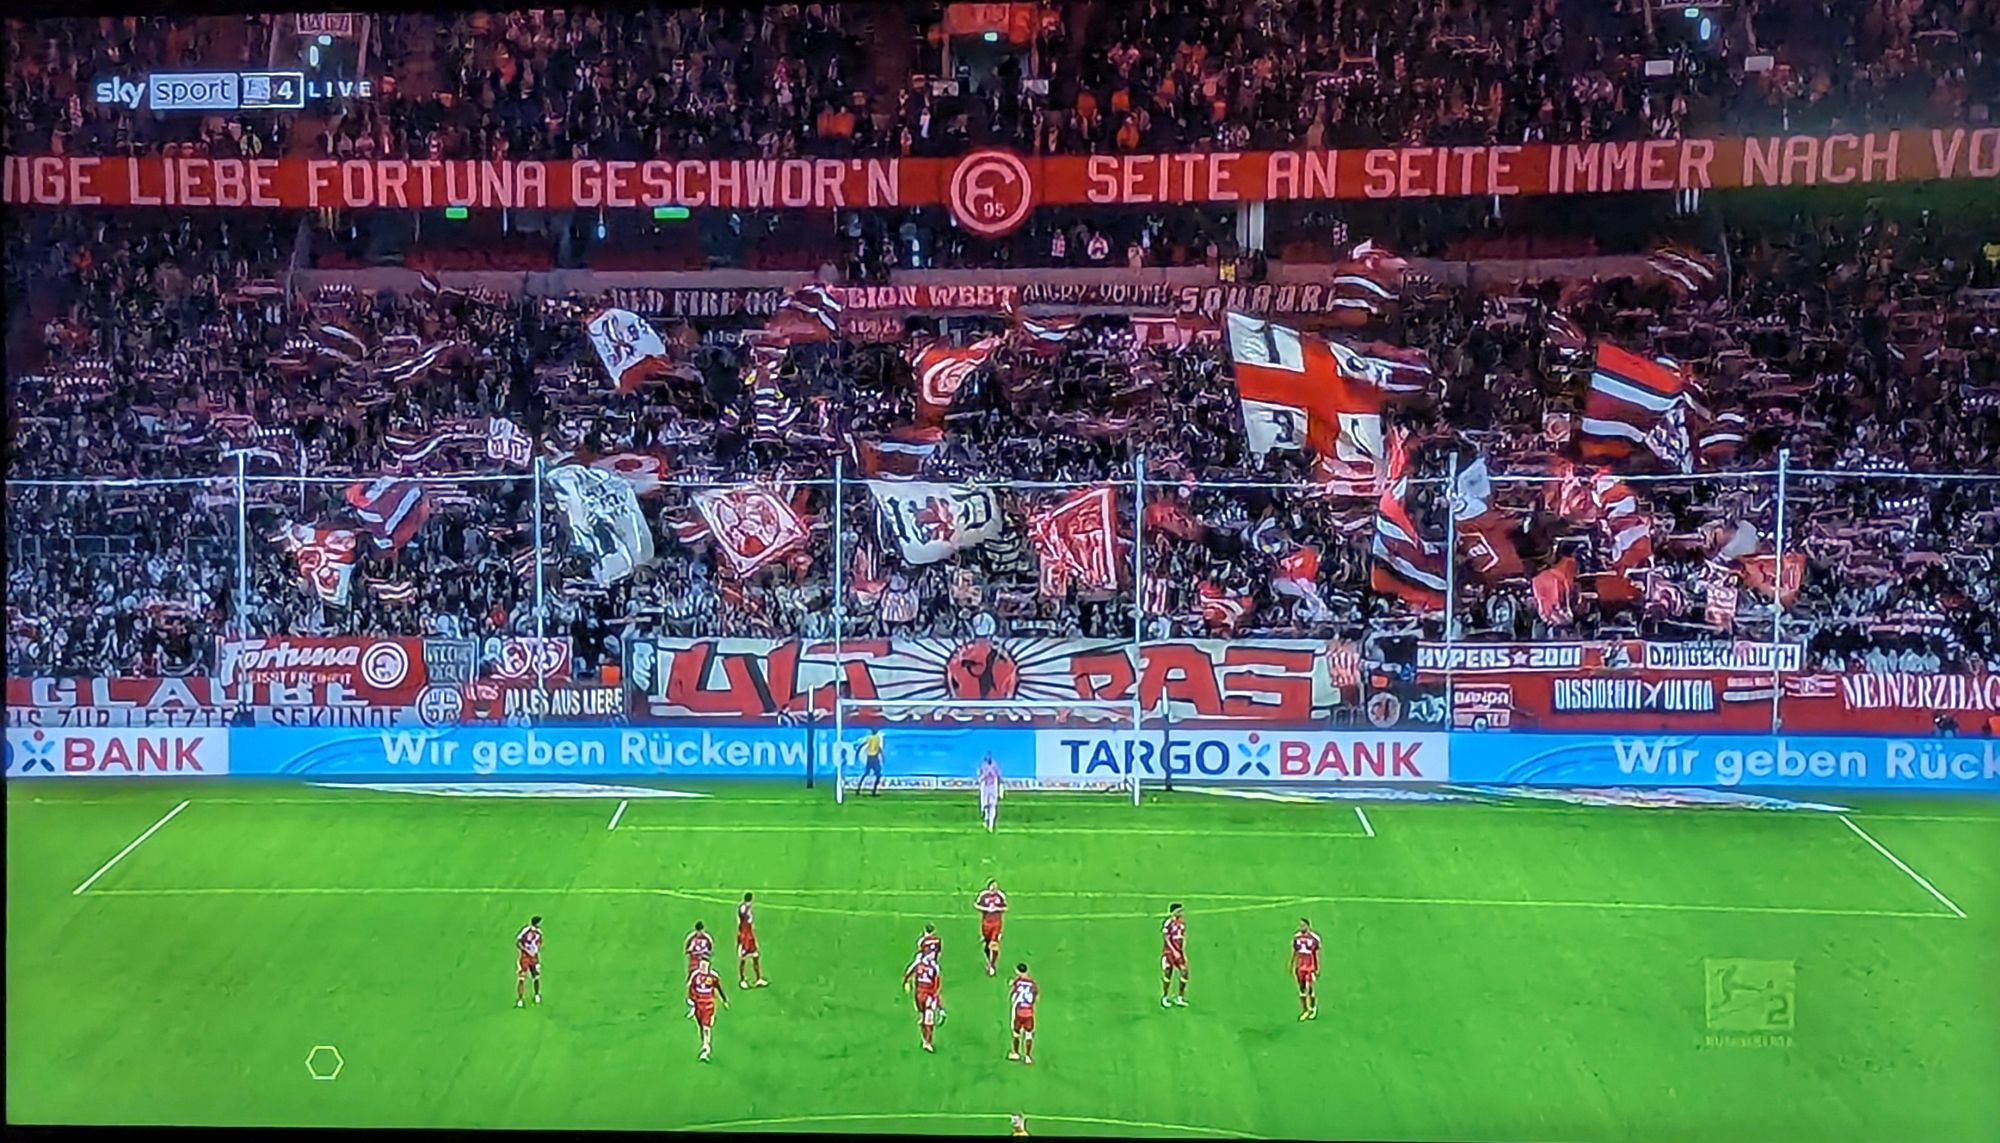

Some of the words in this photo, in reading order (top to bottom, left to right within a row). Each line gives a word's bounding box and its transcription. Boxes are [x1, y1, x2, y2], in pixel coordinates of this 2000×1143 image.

[96, 76, 145, 109] sky
[155, 79, 231, 104] sport
[277, 80, 294, 100] 4
[308, 81, 372, 98] LIVE
[128, 157, 281, 206] LIEBE
[308, 157, 546, 208] FORTUNA
[572, 158, 901, 208] GESCHWOR'N
[1087, 152, 1241, 204] SEITE
[1266, 150, 1337, 200] AN
[1364, 145, 1522, 198] SEITE
[1548, 138, 1716, 195] IMMER
[1742, 130, 1900, 188] NACH
[221, 639, 361, 687] Fortuna
[1416, 647, 1511, 669] HYPERS
[1529, 647, 1581, 668] 2001
[551, 688, 581, 716] AUS
[64, 737, 205, 772] BANK
[381, 731, 459, 767] Wir
[472, 730, 606, 775] geben
[1060, 739, 1231, 775] TARGO
[1279, 741, 1424, 778] BANK
[1613, 739, 1700, 777] Wir
[1715, 739, 1868, 786] geben
